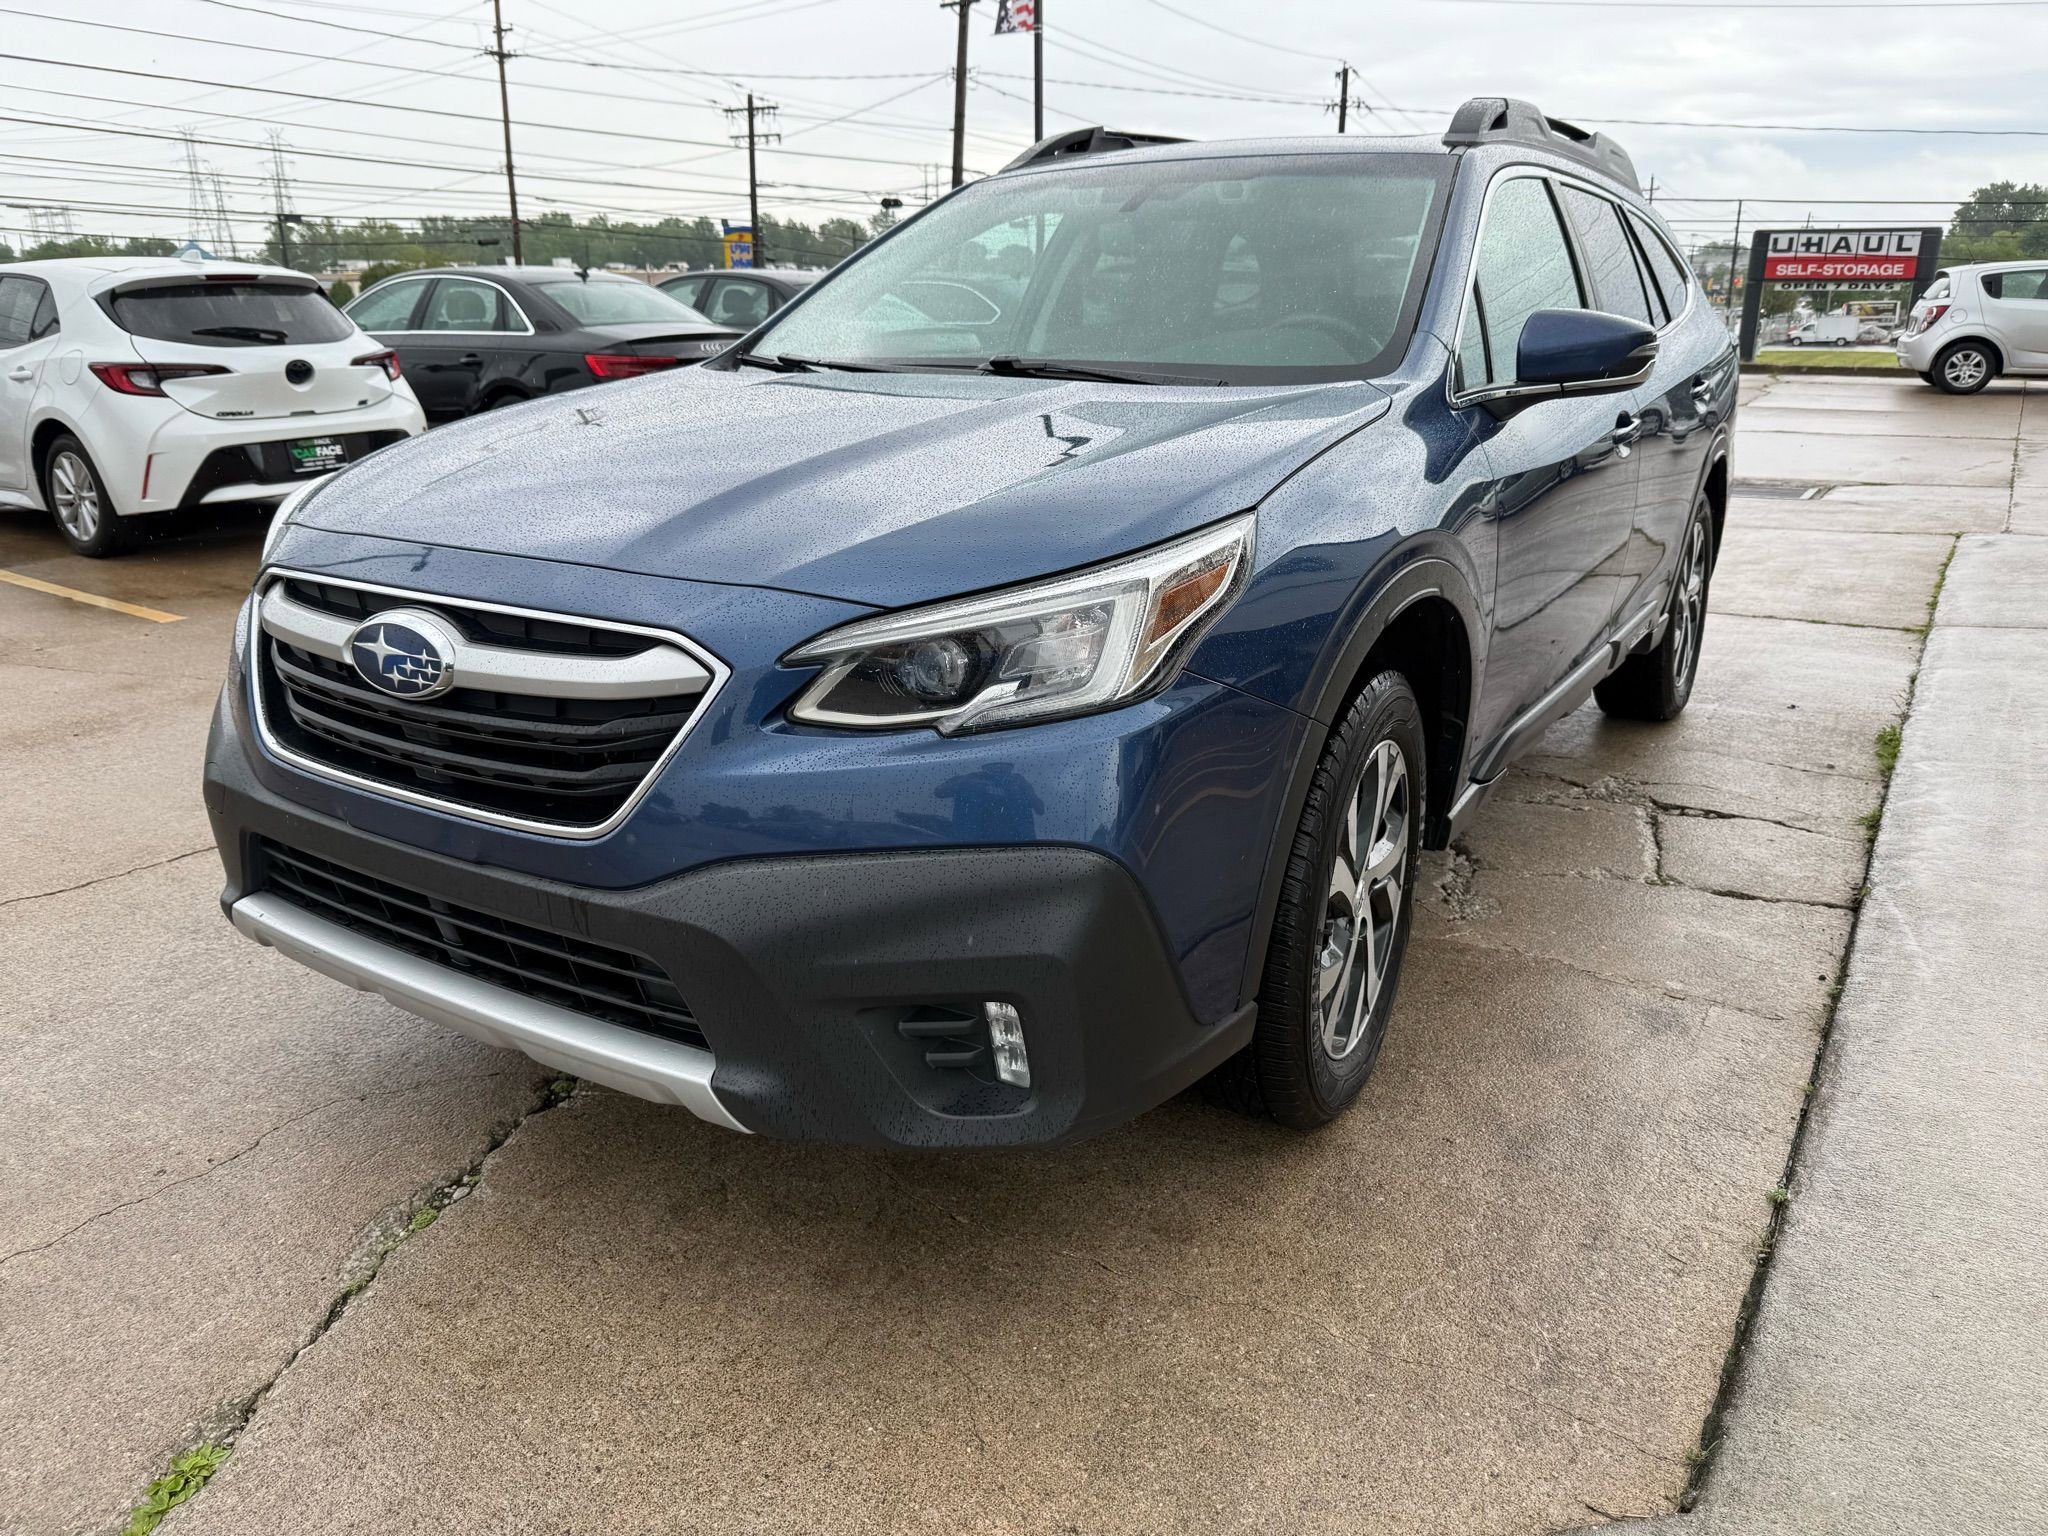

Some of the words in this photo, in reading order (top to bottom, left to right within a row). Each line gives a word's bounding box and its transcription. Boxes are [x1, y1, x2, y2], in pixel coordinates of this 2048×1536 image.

[1775, 263, 1905, 276] SELF-STORAGE
[1780, 282, 1827, 290] OPEN
[1833, 282, 1842, 290] 7
[1847, 282, 1895, 290] DAYS
